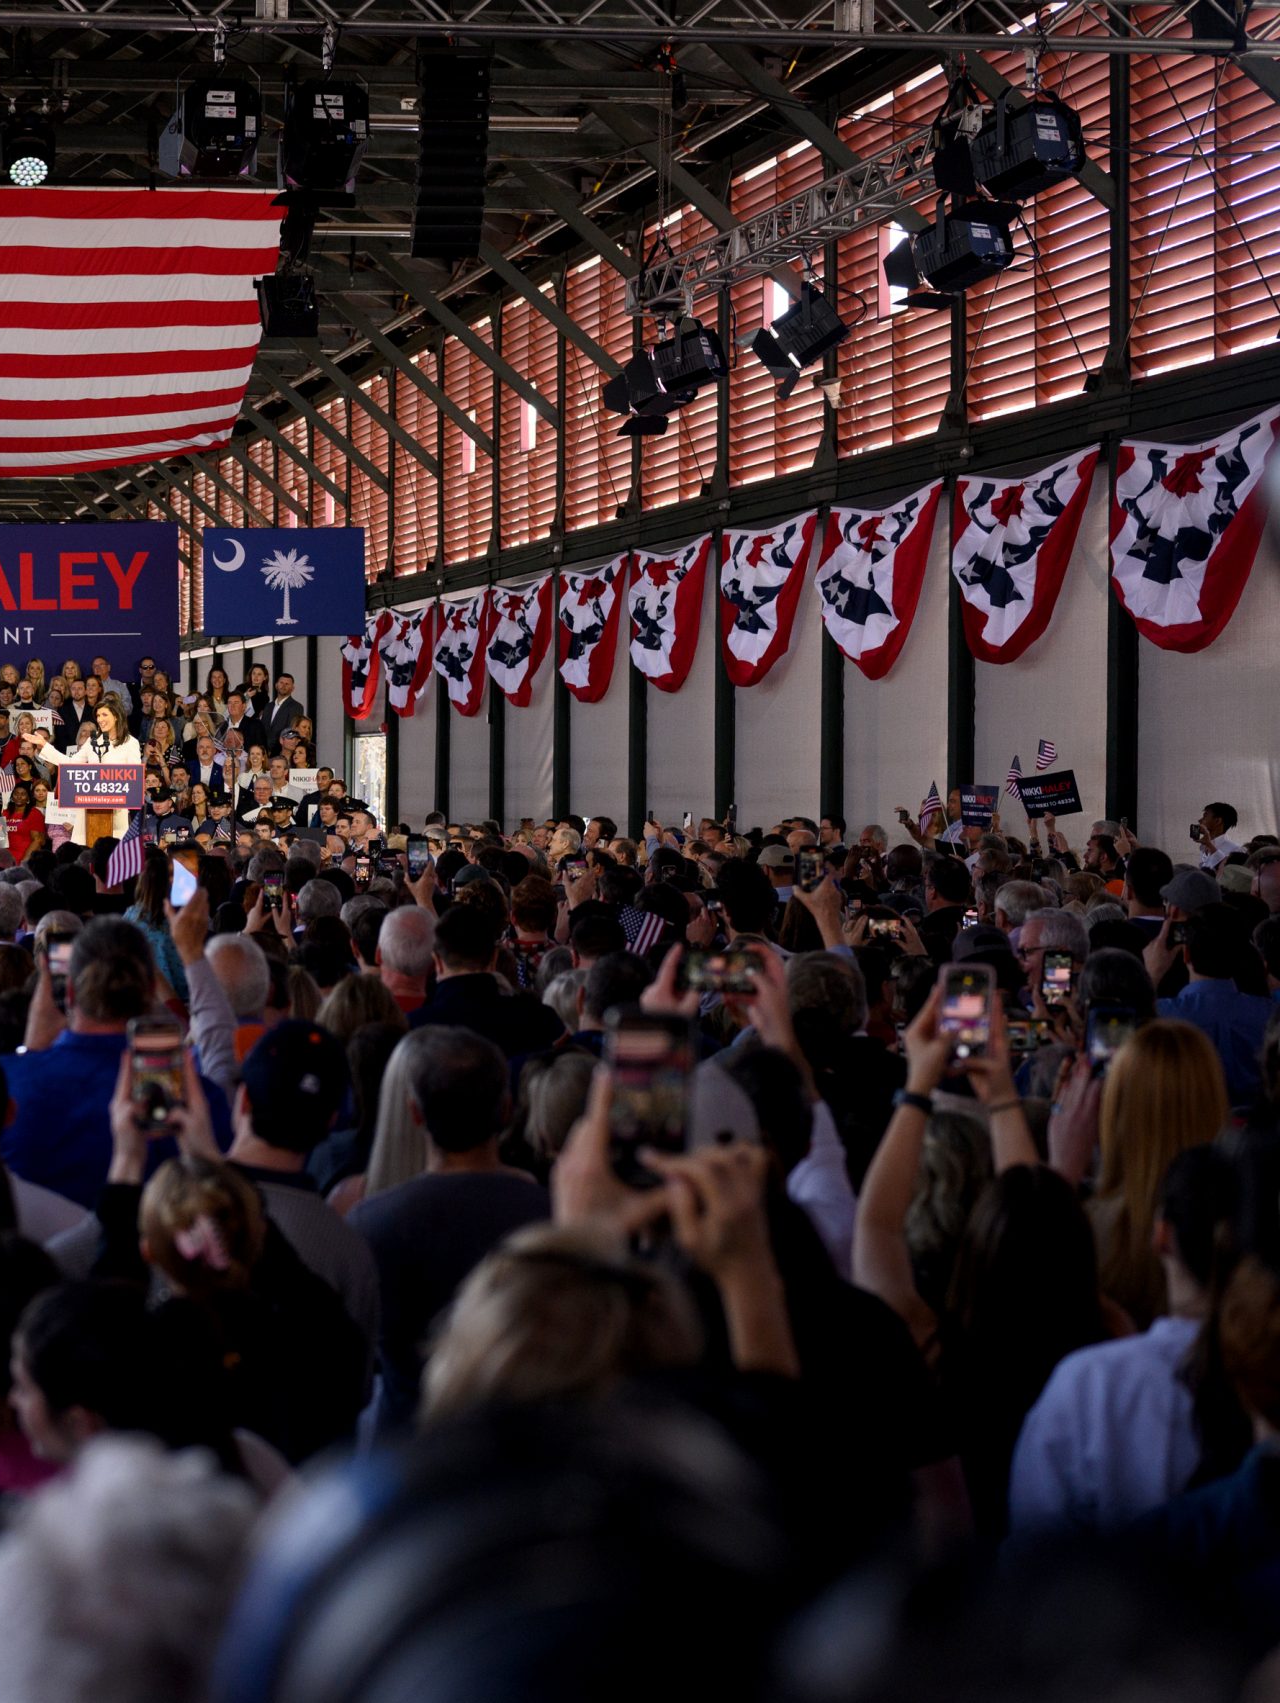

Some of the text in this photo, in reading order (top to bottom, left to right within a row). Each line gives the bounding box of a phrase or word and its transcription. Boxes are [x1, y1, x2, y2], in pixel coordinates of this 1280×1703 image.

[67, 769, 137, 781] TEXT NIKKI
[74, 782, 130, 793] TO 48324
[77, 796, 124, 805] NikkiHaley.com
